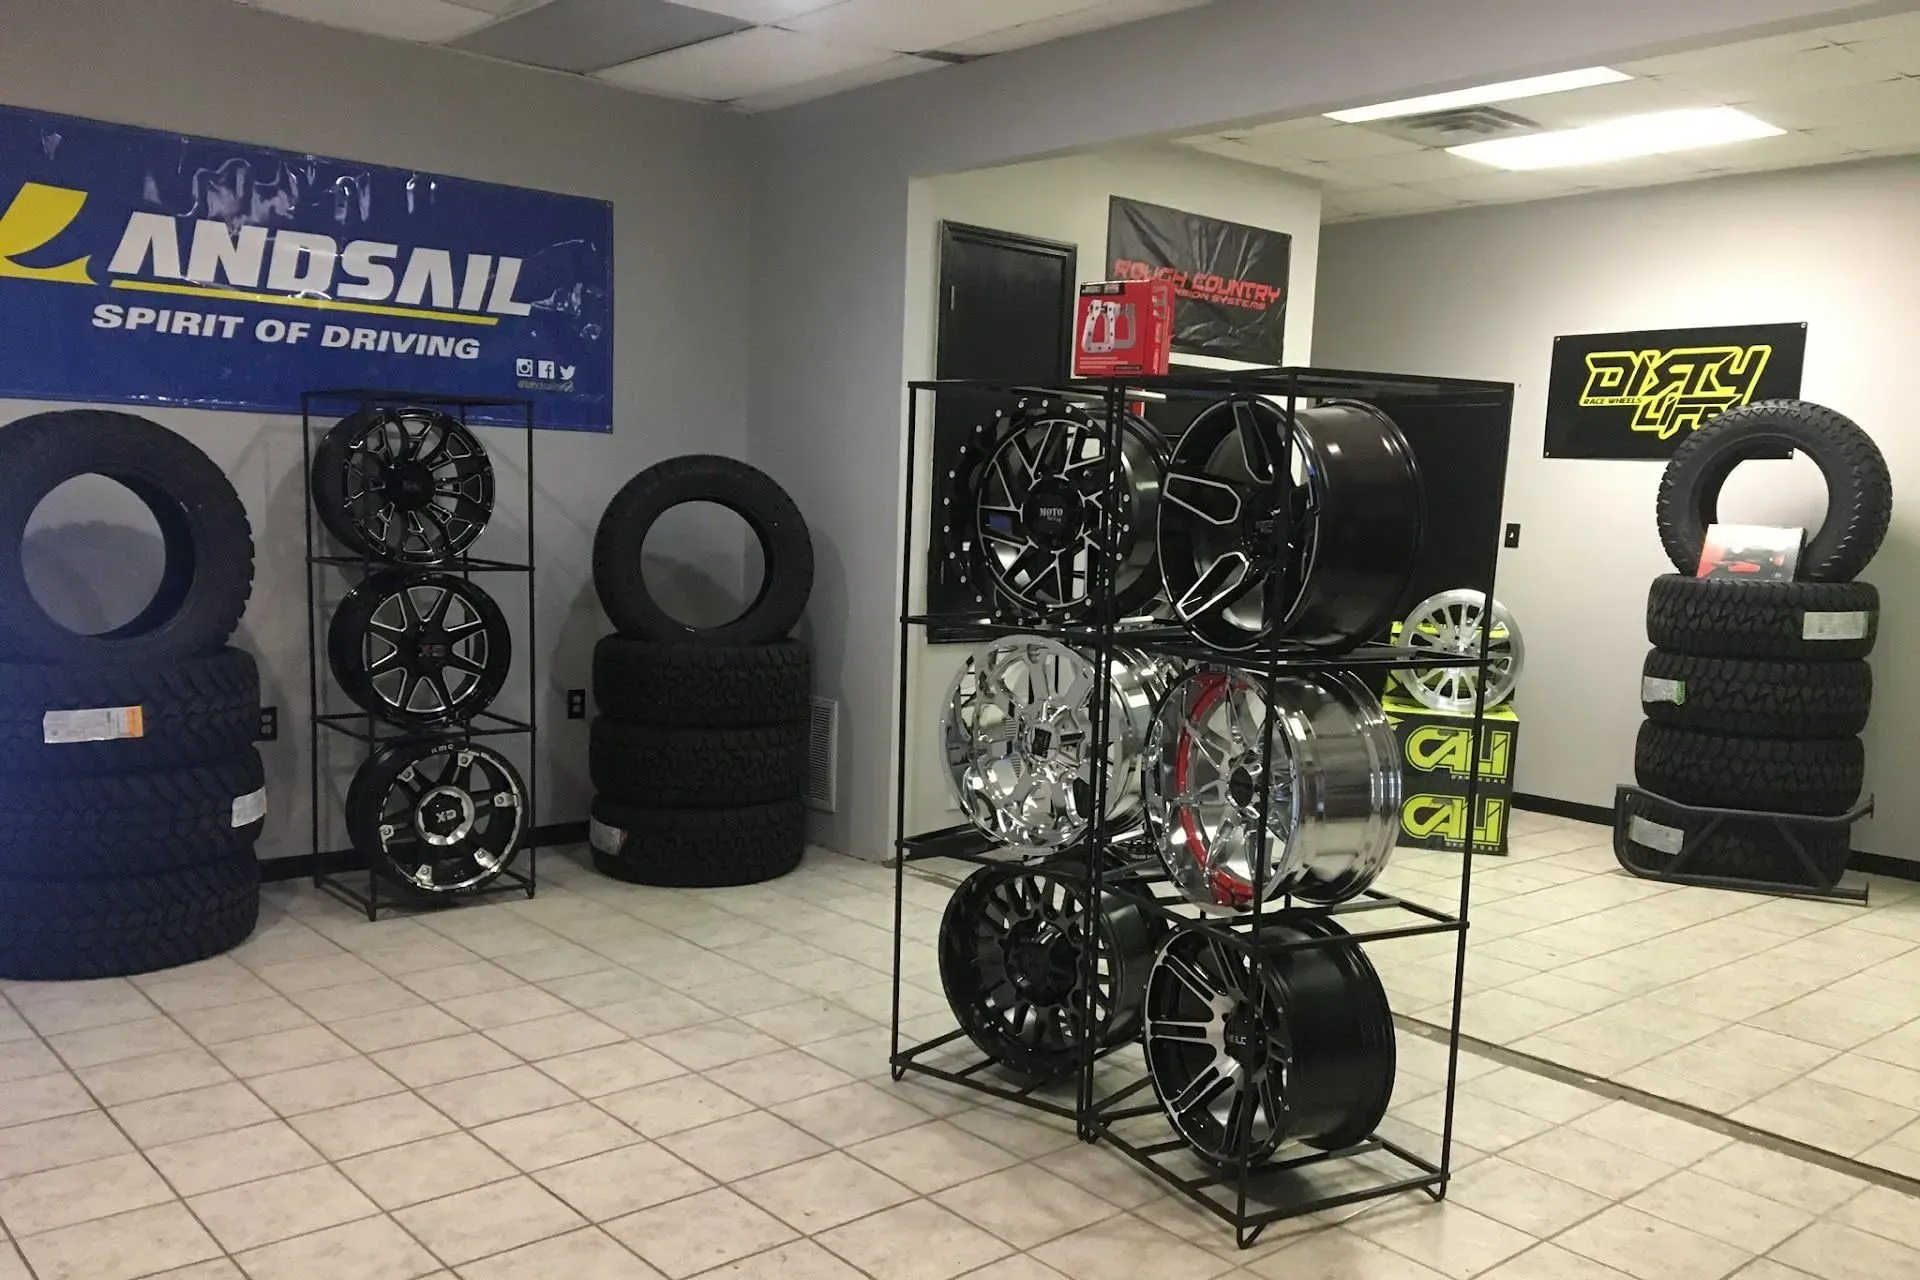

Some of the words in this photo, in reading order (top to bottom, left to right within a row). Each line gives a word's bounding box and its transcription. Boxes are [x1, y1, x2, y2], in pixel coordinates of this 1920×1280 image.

[1192, 272, 1280, 304] COUNTRY
[91, 303, 244, 338] SPIRIT
[255, 319, 311, 344] OF
[320, 325, 480, 360] DRIVING
[1580, 344, 1772, 405] DIRTY
[1608, 397, 1643, 405] WHEELS
[1039, 507, 1064, 517] MOTO
[435, 809, 457, 823] XD
